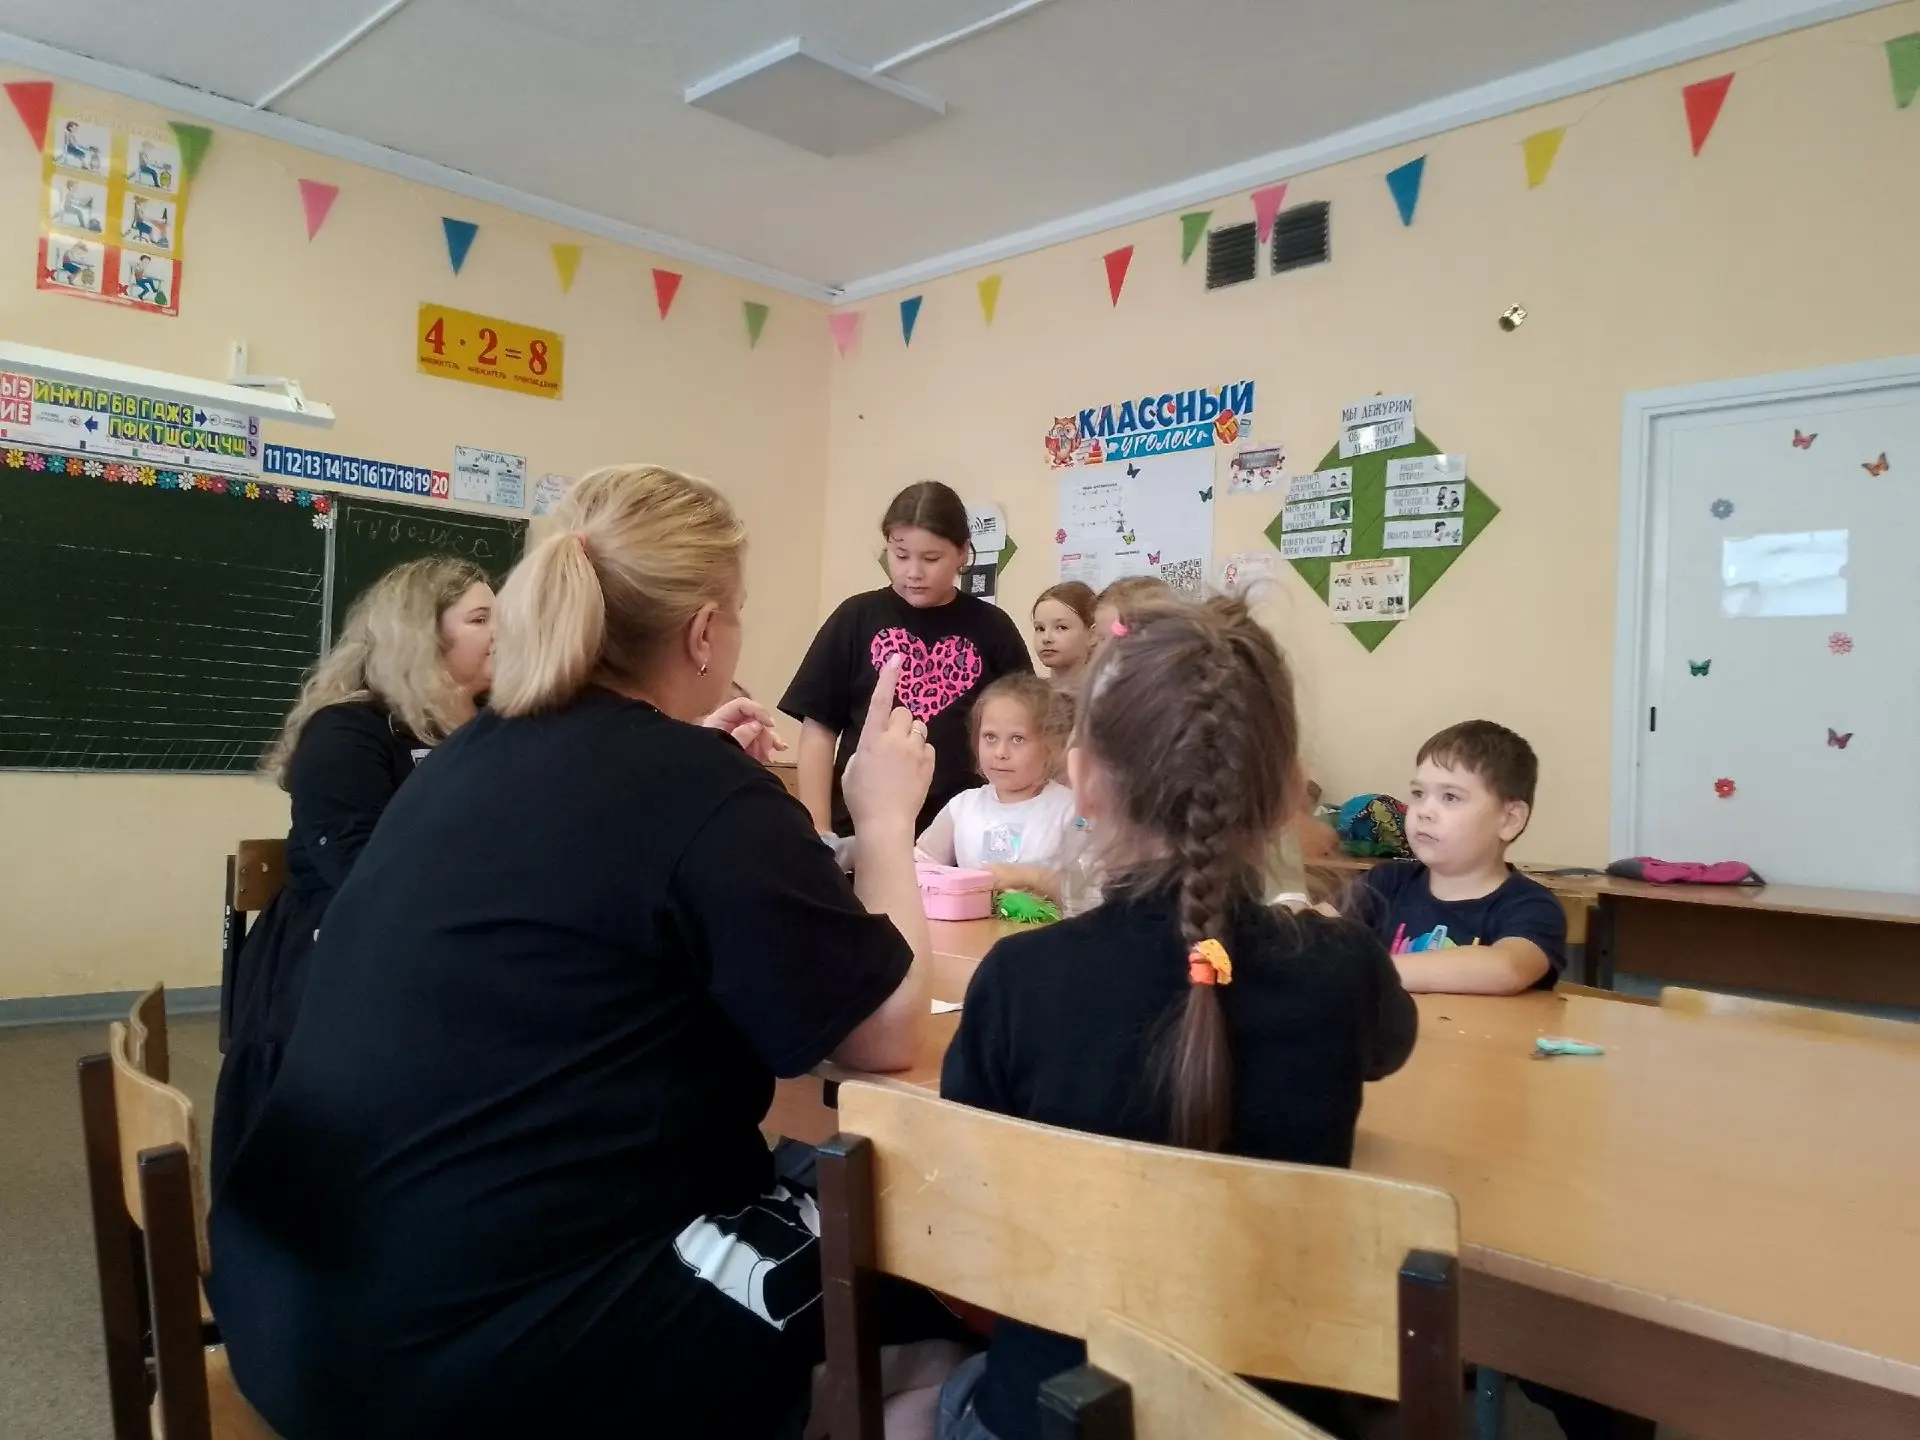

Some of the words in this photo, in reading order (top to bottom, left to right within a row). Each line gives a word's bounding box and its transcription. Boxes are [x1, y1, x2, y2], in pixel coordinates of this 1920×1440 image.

[425, 317, 445, 355] 4
[478, 327, 498, 366] 2
[528, 339, 548, 376] 8
[1079, 380, 1255, 438] КЛАССНЫЙ
[1342, 407, 1358, 422] МЫ
[1361, 399, 1412, 420] ДЕЖУРИМ
[1121, 428, 1198, 457] УГОЛОК
[265, 448, 281, 470] 11
[285, 452, 302, 473] 12
[304, 454, 321, 476] 13
[324, 458, 341, 479] 14
[343, 461, 359, 482] 15
[362, 464, 378, 485] 16
[380, 466, 396, 487] 17
[397, 470, 413, 490] 18
[415, 472, 430, 492] 19
[432, 475, 448, 494] 20
